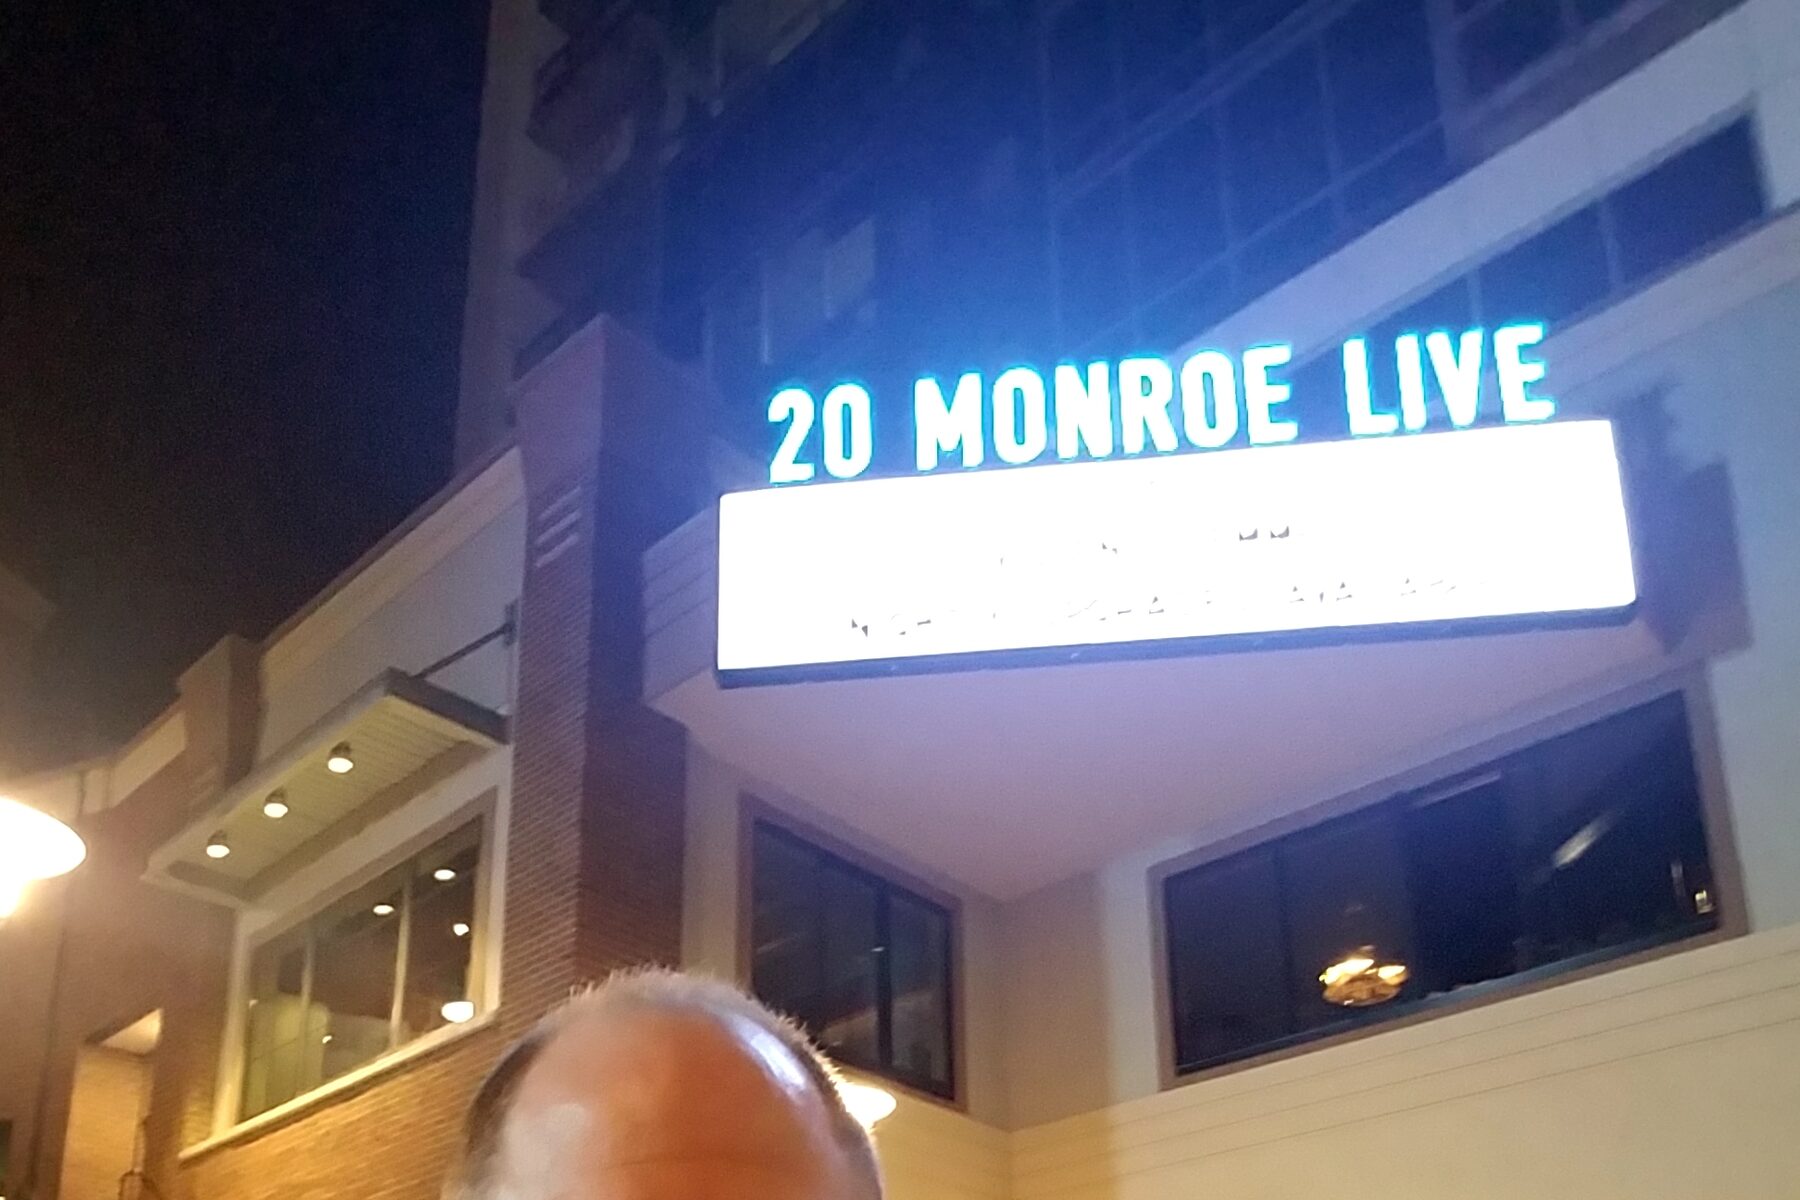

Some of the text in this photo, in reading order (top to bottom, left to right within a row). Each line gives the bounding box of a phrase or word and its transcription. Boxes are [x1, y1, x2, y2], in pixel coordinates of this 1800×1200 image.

[767, 322, 1557, 484] 20 MONROE LIVE
